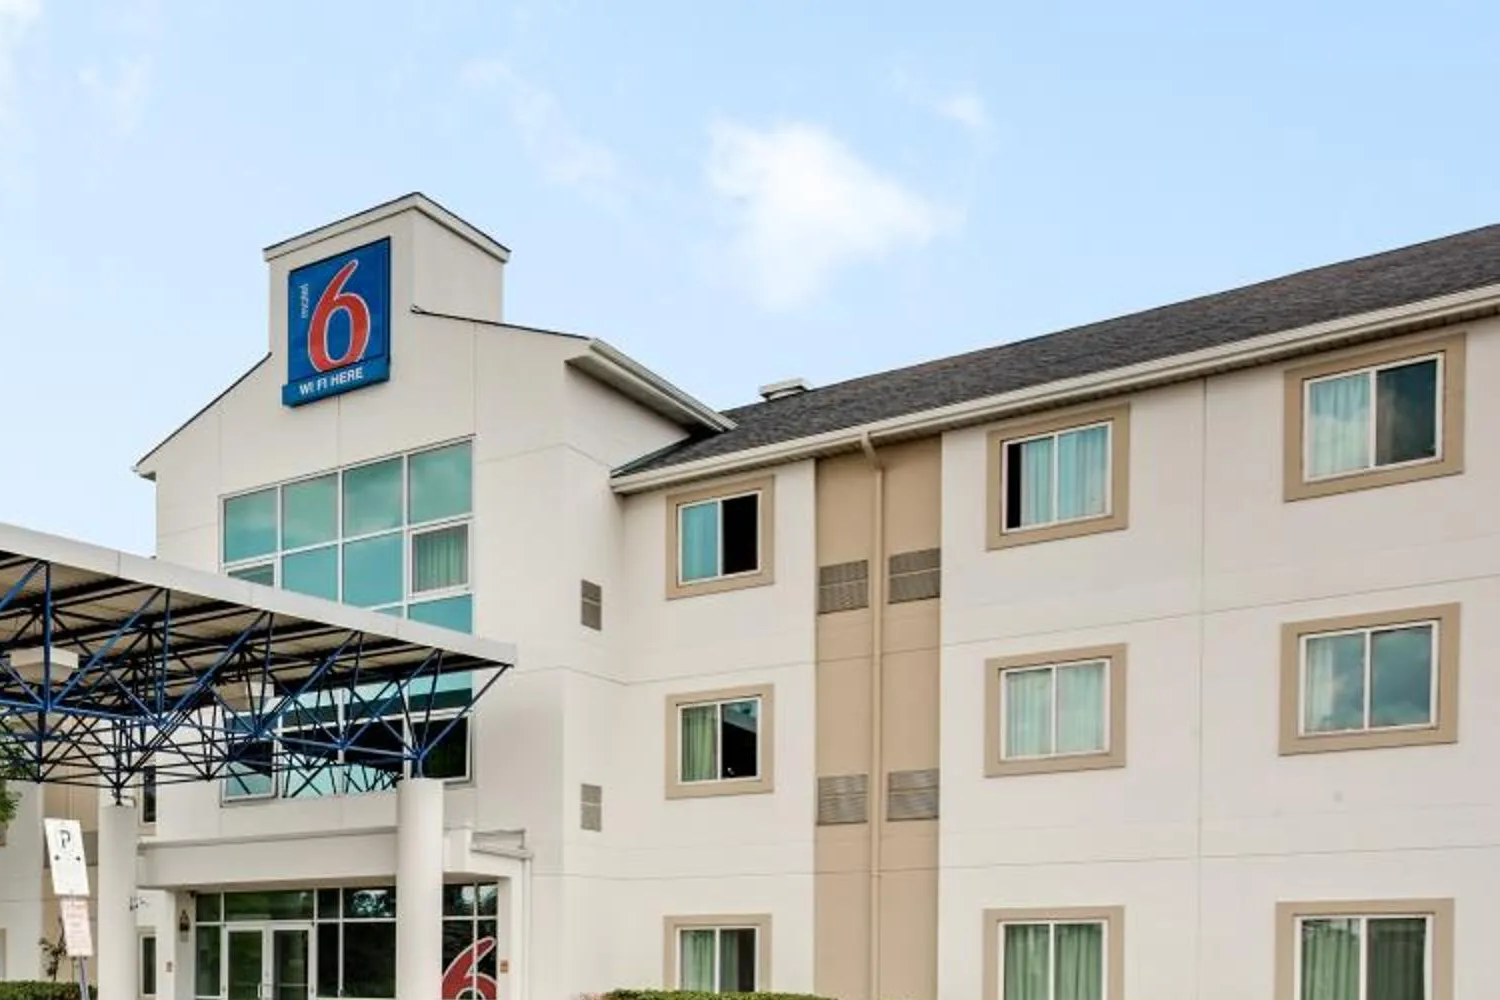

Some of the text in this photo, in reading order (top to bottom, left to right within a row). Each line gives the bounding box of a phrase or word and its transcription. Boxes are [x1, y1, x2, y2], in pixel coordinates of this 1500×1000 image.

[308, 259, 371, 373] 6
[317, 376, 328, 391] FI
[331, 367, 364, 386] HERE
